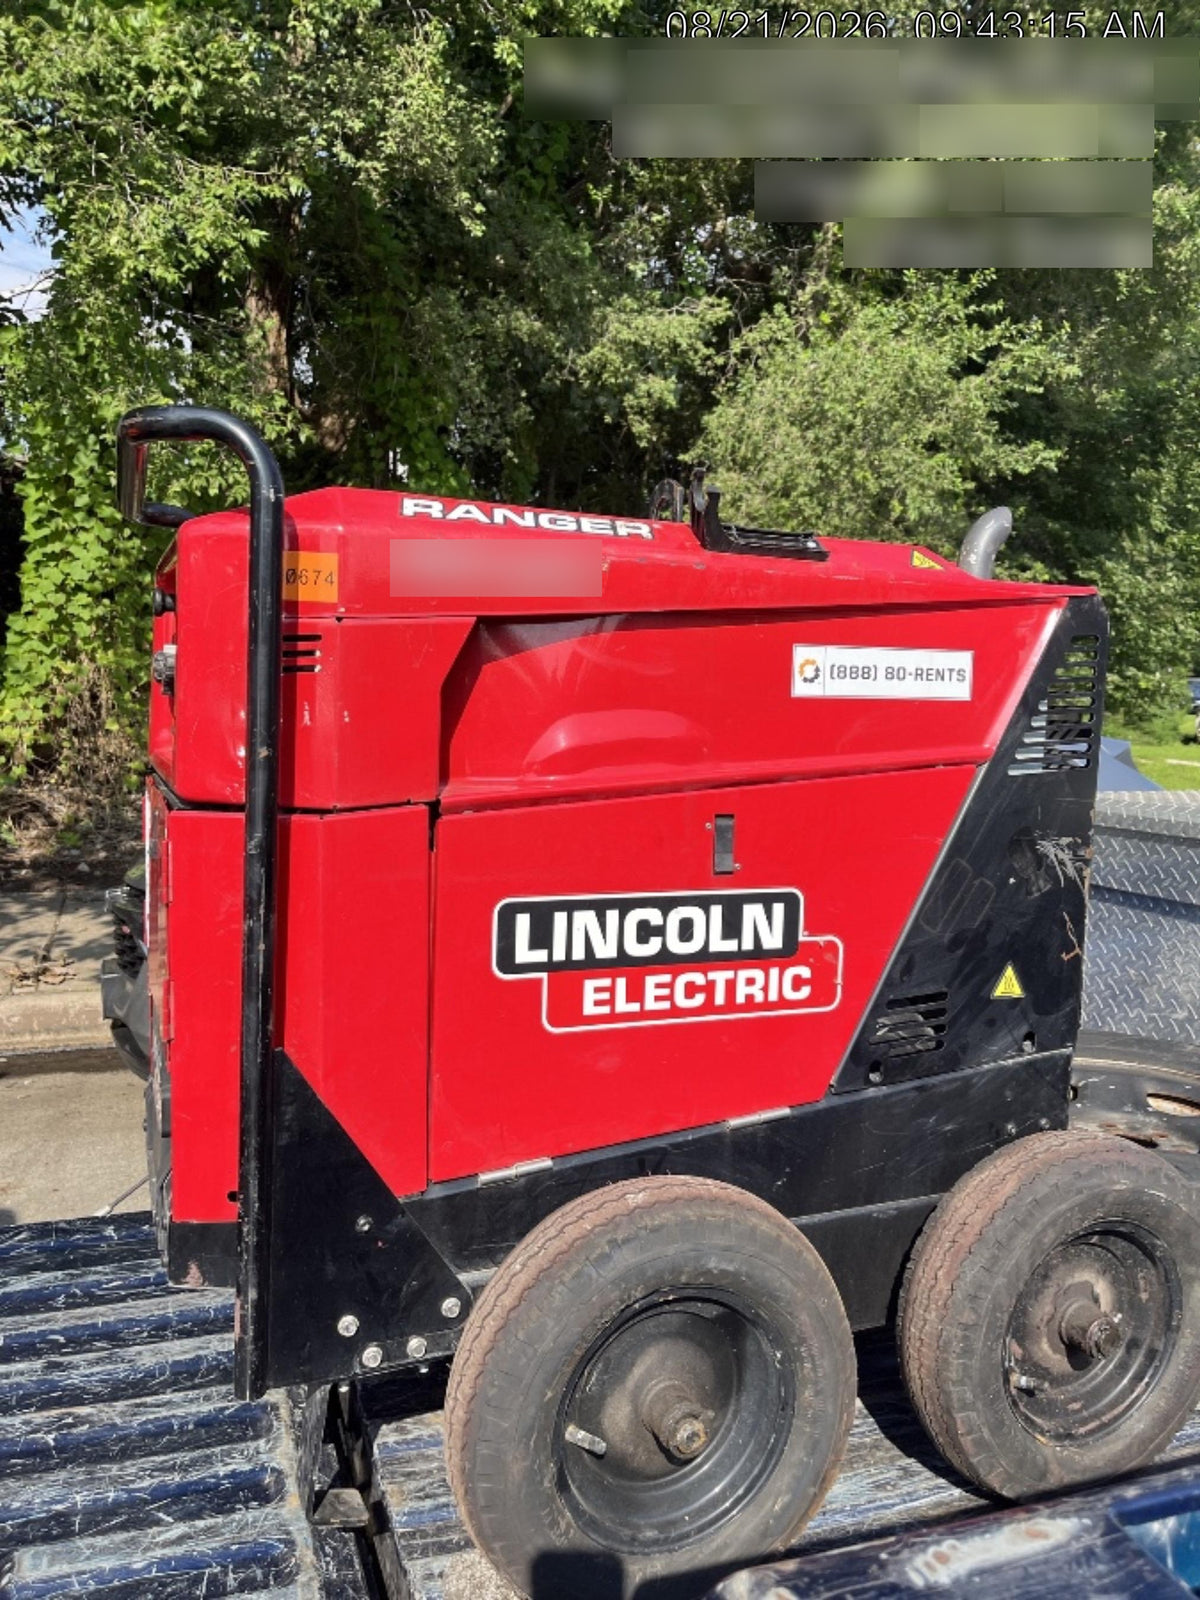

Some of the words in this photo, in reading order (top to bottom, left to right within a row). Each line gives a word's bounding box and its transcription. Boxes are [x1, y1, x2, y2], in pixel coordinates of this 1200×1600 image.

[401, 497, 654, 540] RANGER
[829, 664, 878, 682] (888)
[884, 666, 967, 683] 80-RENTS
[514, 902, 785, 964] LINCOLN
[582, 965, 812, 1016] ELECTRIC
